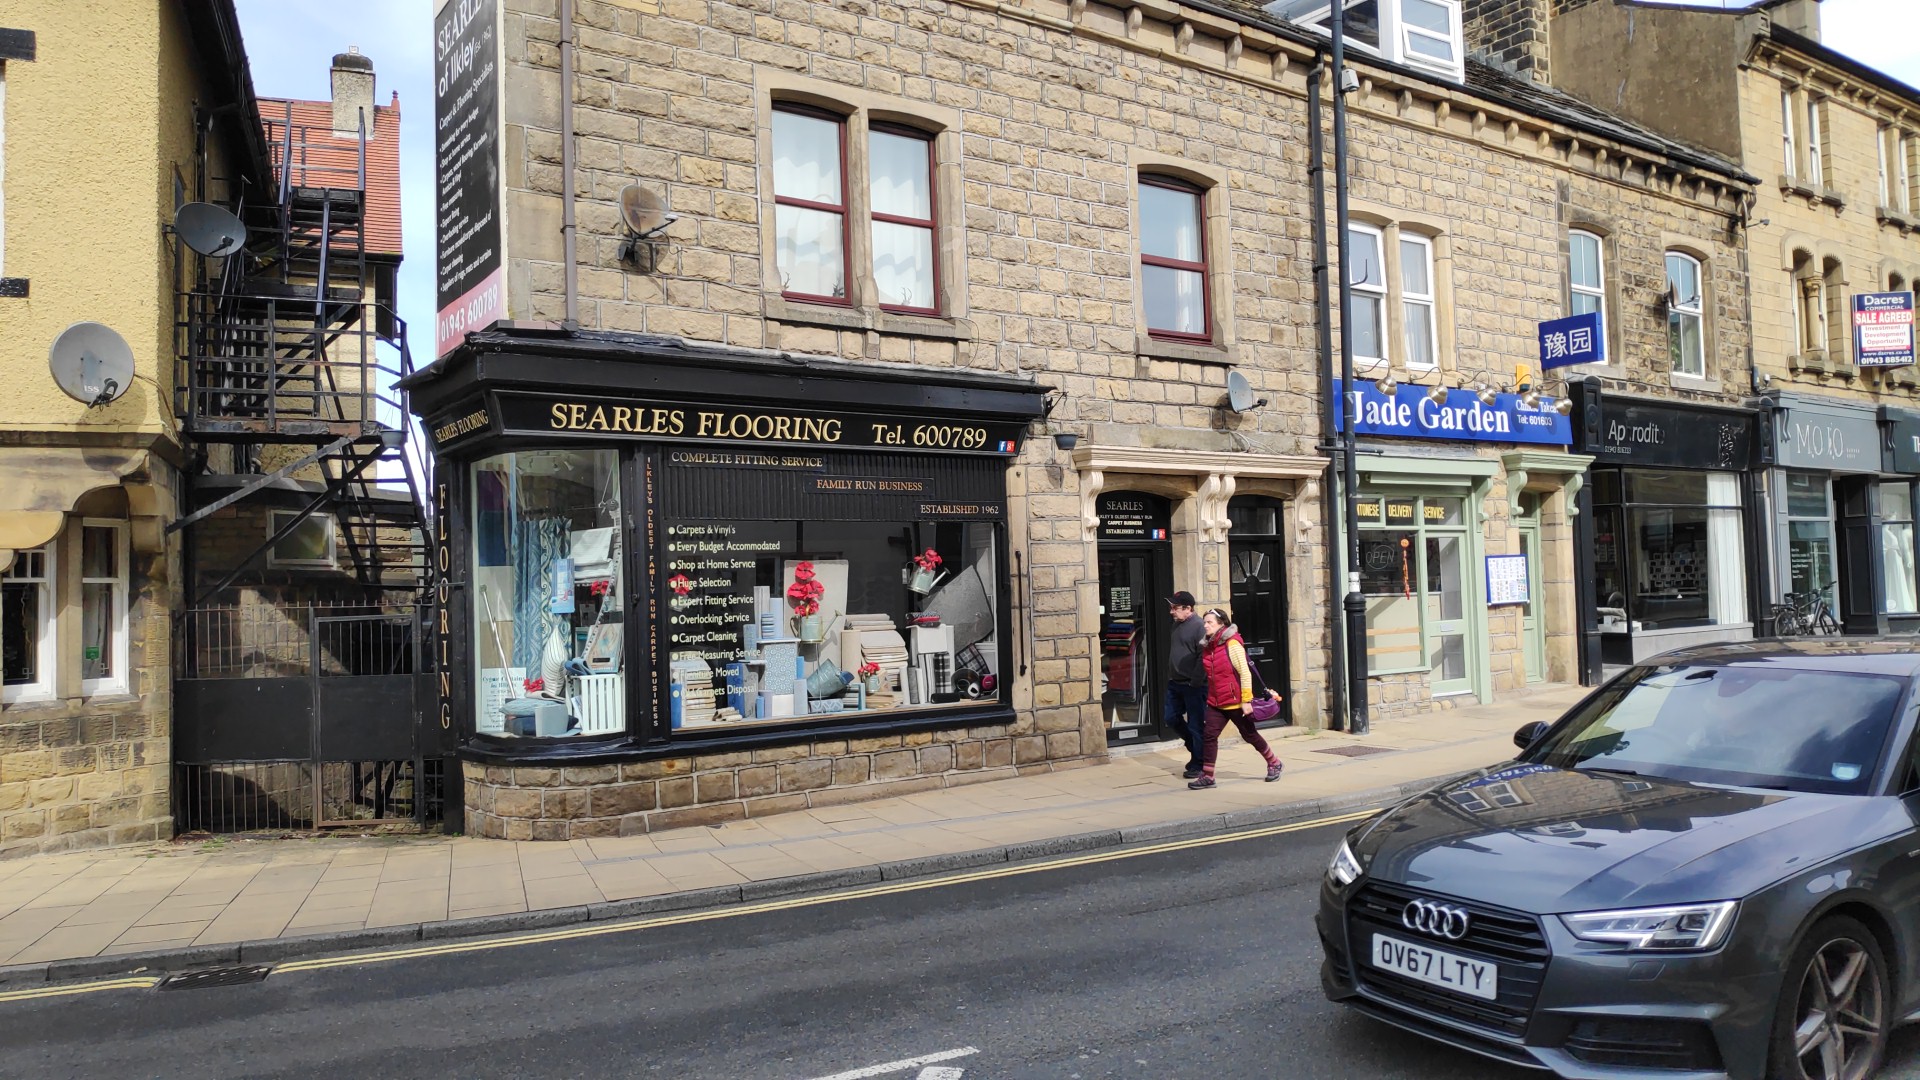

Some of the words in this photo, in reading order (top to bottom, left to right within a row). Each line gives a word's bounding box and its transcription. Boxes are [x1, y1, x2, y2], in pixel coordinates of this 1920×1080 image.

[439, 61, 448, 98] of
[451, 37, 474, 84] Ilkley
[457, 87, 472, 111] Flooring
[1864, 296, 1904, 306] Dacres
[441, 307, 465, 342] 01943
[468, 283, 498, 325] 600789
[1856, 312, 1877, 324] SALE
[1878, 311, 1912, 323] AGREED
[1544, 326, 1592, 360] 豫园
[1353, 390, 1411, 427] Jade
[1418, 396, 1510, 433] Garden
[435, 422, 458, 443] SEARLES
[457, 409, 488, 434] FLOORING
[550, 403, 684, 435] SEARLES
[697, 411, 842, 442] FLOORING
[872, 424, 905, 445] Tel.
[912, 425, 987, 448] 600789
[1529, 416, 1552, 426] 601603
[672, 452, 732, 464] COMPLETE
[735, 455, 779, 465] FITTING
[782, 456, 823, 467] SERVICE
[817, 479, 852, 490] FAMILY
[855, 480, 876, 490] RUN
[879, 481, 923, 491] BUSINESS
[920, 505, 978, 514] ESTABLISHED
[981, 505, 999, 514] 1962
[1106, 500, 1144, 510] SEARLES
[1388, 504, 1412, 518] DELIVERY
[1424, 506, 1444, 519] SERVICE
[676, 524, 705, 536] Carpets
[707, 526, 713, 534] &
[714, 525, 736, 537] Vinyl's
[677, 542, 697, 554] Every
[700, 541, 724, 554] Budget
[726, 541, 780, 551] Accommodated
[1366, 551, 1394, 564] OPEN
[677, 560, 695, 572] Shop
[698, 561, 705, 569] at
[706, 559, 728, 568] Home
[730, 559, 756, 568] Service
[678, 579, 697, 590] Huge
[699, 578, 731, 587] Selection
[438, 483, 450, 729] FLOORING
[678, 596, 703, 608] Expert
[704, 595, 727, 608] Fitting
[729, 594, 753, 604] Service
[679, 613, 723, 626] Overlocking
[724, 613, 750, 623] Service
[679, 633, 705, 645] Carpet
[706, 631, 737, 642] Cleaning
[699, 650, 734, 660] Measuring
[736, 648, 760, 658] Service
[716, 667, 739, 677] Moved
[727, 685, 757, 696] Disposal
[1382, 940, 1433, 976] OV67
[1440, 956, 1485, 989] LTY
